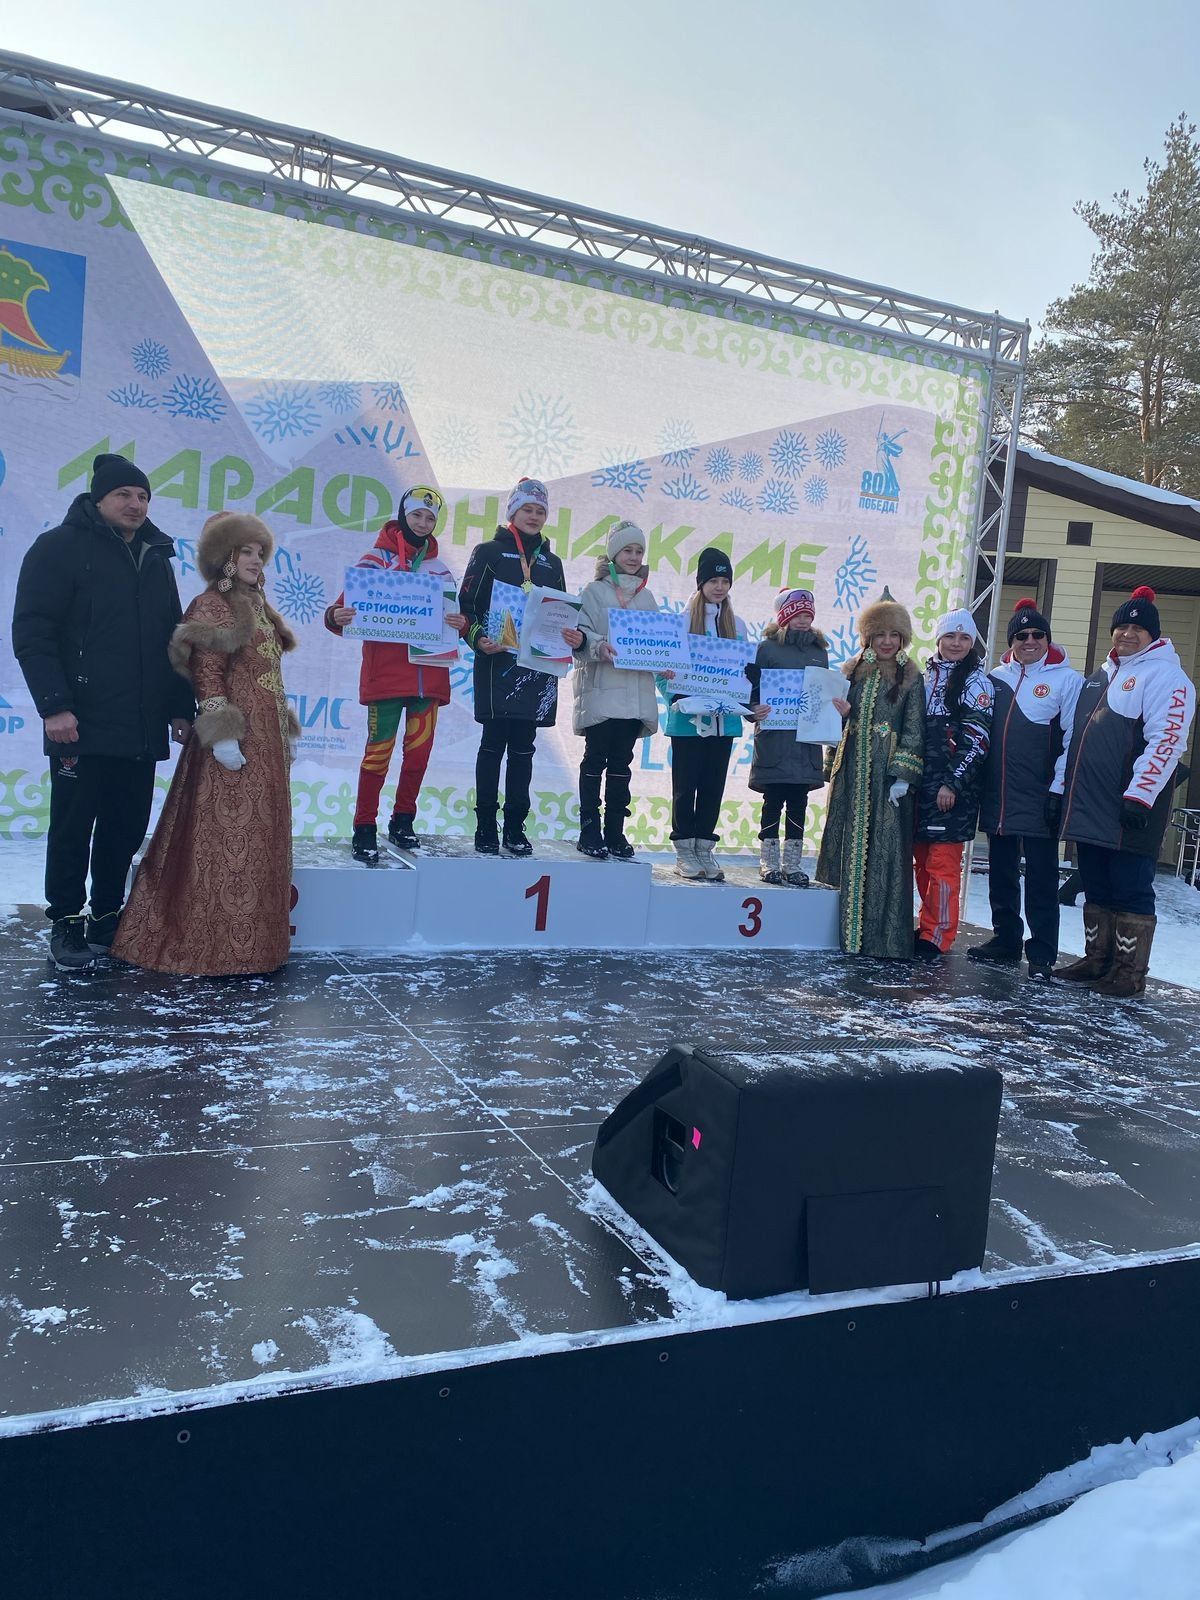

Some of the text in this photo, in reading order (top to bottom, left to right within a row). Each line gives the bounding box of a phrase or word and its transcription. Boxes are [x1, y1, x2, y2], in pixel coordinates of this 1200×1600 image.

[861, 470, 883, 495] 80
[859, 497, 898, 514] ПОБЕДА!
[351, 600, 434, 617] СЕРТИФИКАТ
[616, 636, 682, 649] СЕРТИФИКАТ
[691, 663, 744, 678] ТИФИКАТ
[1136, 685, 1187, 793] TATARSTAN
[525, 875, 550, 932] 1
[738, 896, 763, 938] 3
